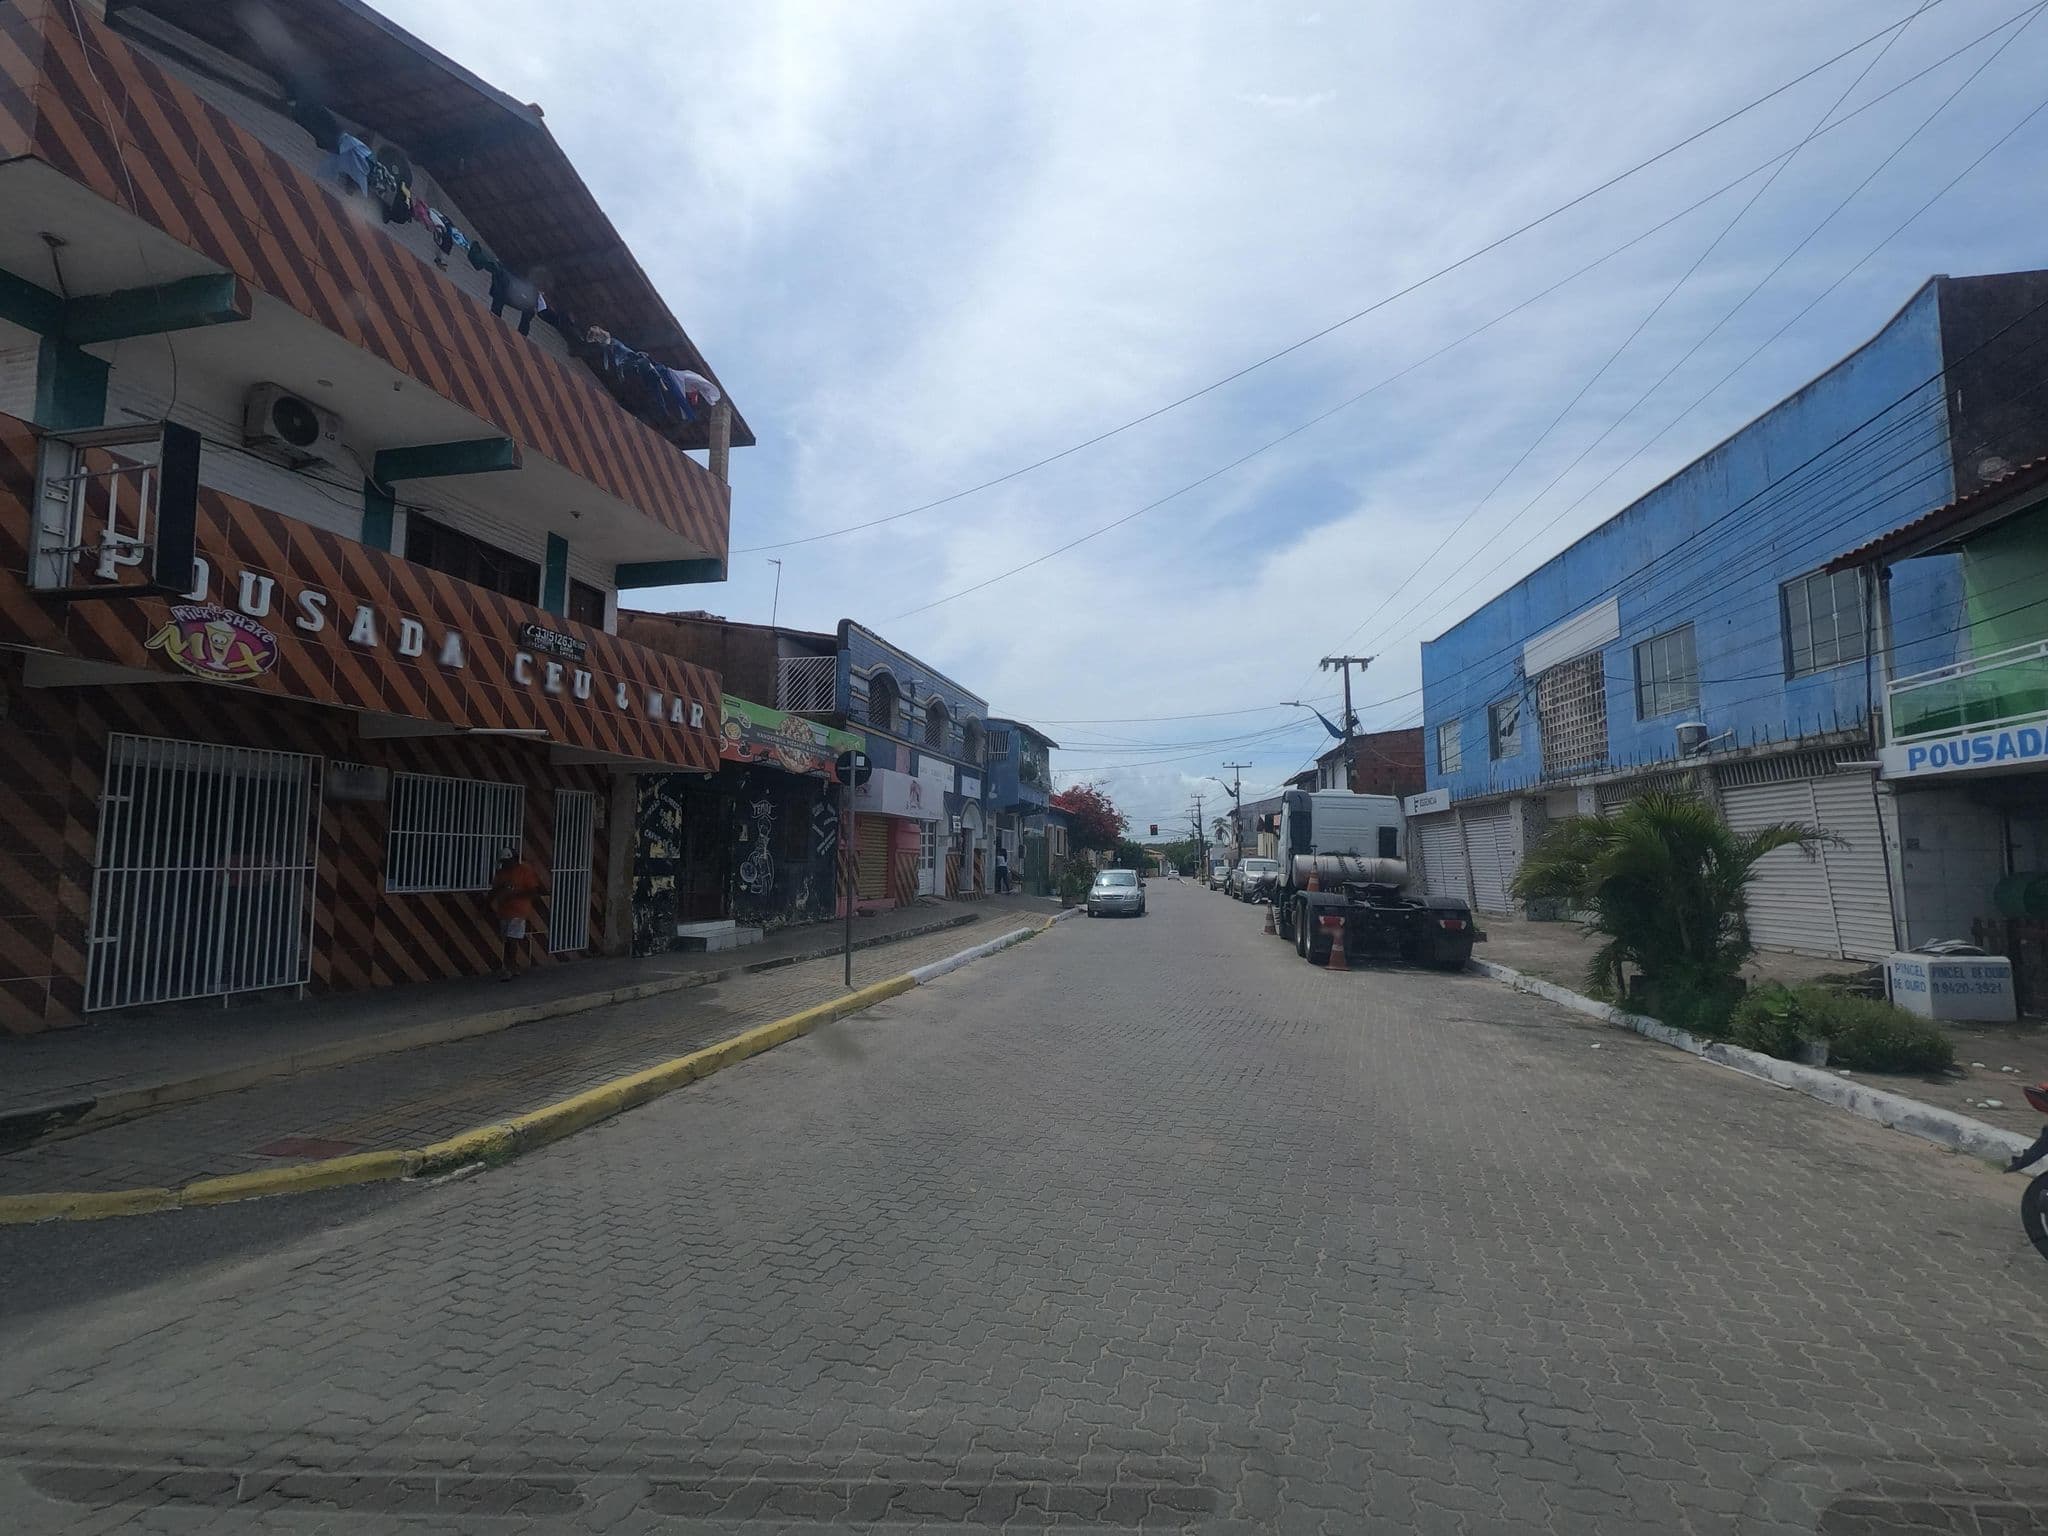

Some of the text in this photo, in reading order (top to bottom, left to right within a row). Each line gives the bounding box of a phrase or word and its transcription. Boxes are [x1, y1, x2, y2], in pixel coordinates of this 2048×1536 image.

[1908, 726, 2048, 771] POUSAD
[1895, 963, 1926, 978] PINCEL
[1893, 978, 1927, 993] DE OURO
